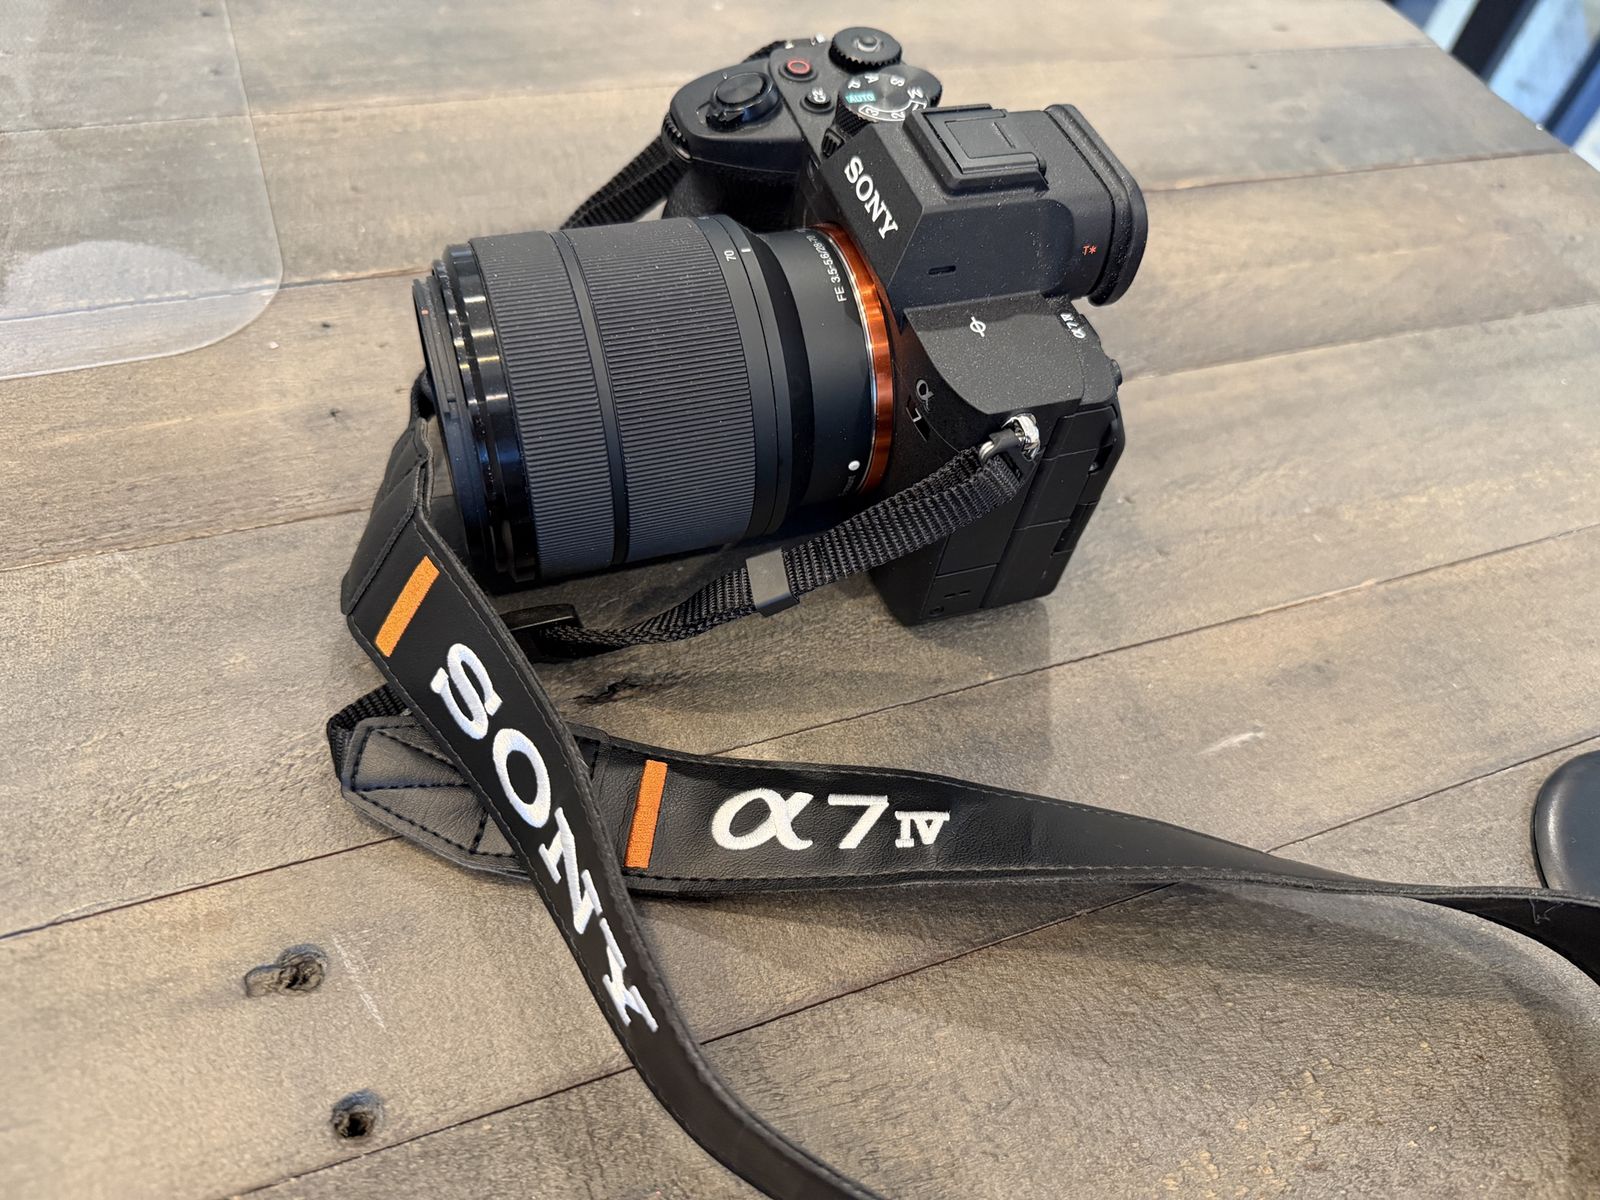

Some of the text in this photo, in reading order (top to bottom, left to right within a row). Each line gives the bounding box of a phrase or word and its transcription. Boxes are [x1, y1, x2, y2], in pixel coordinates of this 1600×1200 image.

[890, 75, 906, 87] S
[907, 86, 923, 99] M
[865, 107, 879, 117] 3
[891, 111, 905, 120] 2
[844, 155, 899, 239] SONY
[724, 250, 737, 262] 70
[834, 286, 847, 302] FE
[430, 643, 660, 1032] SONY
